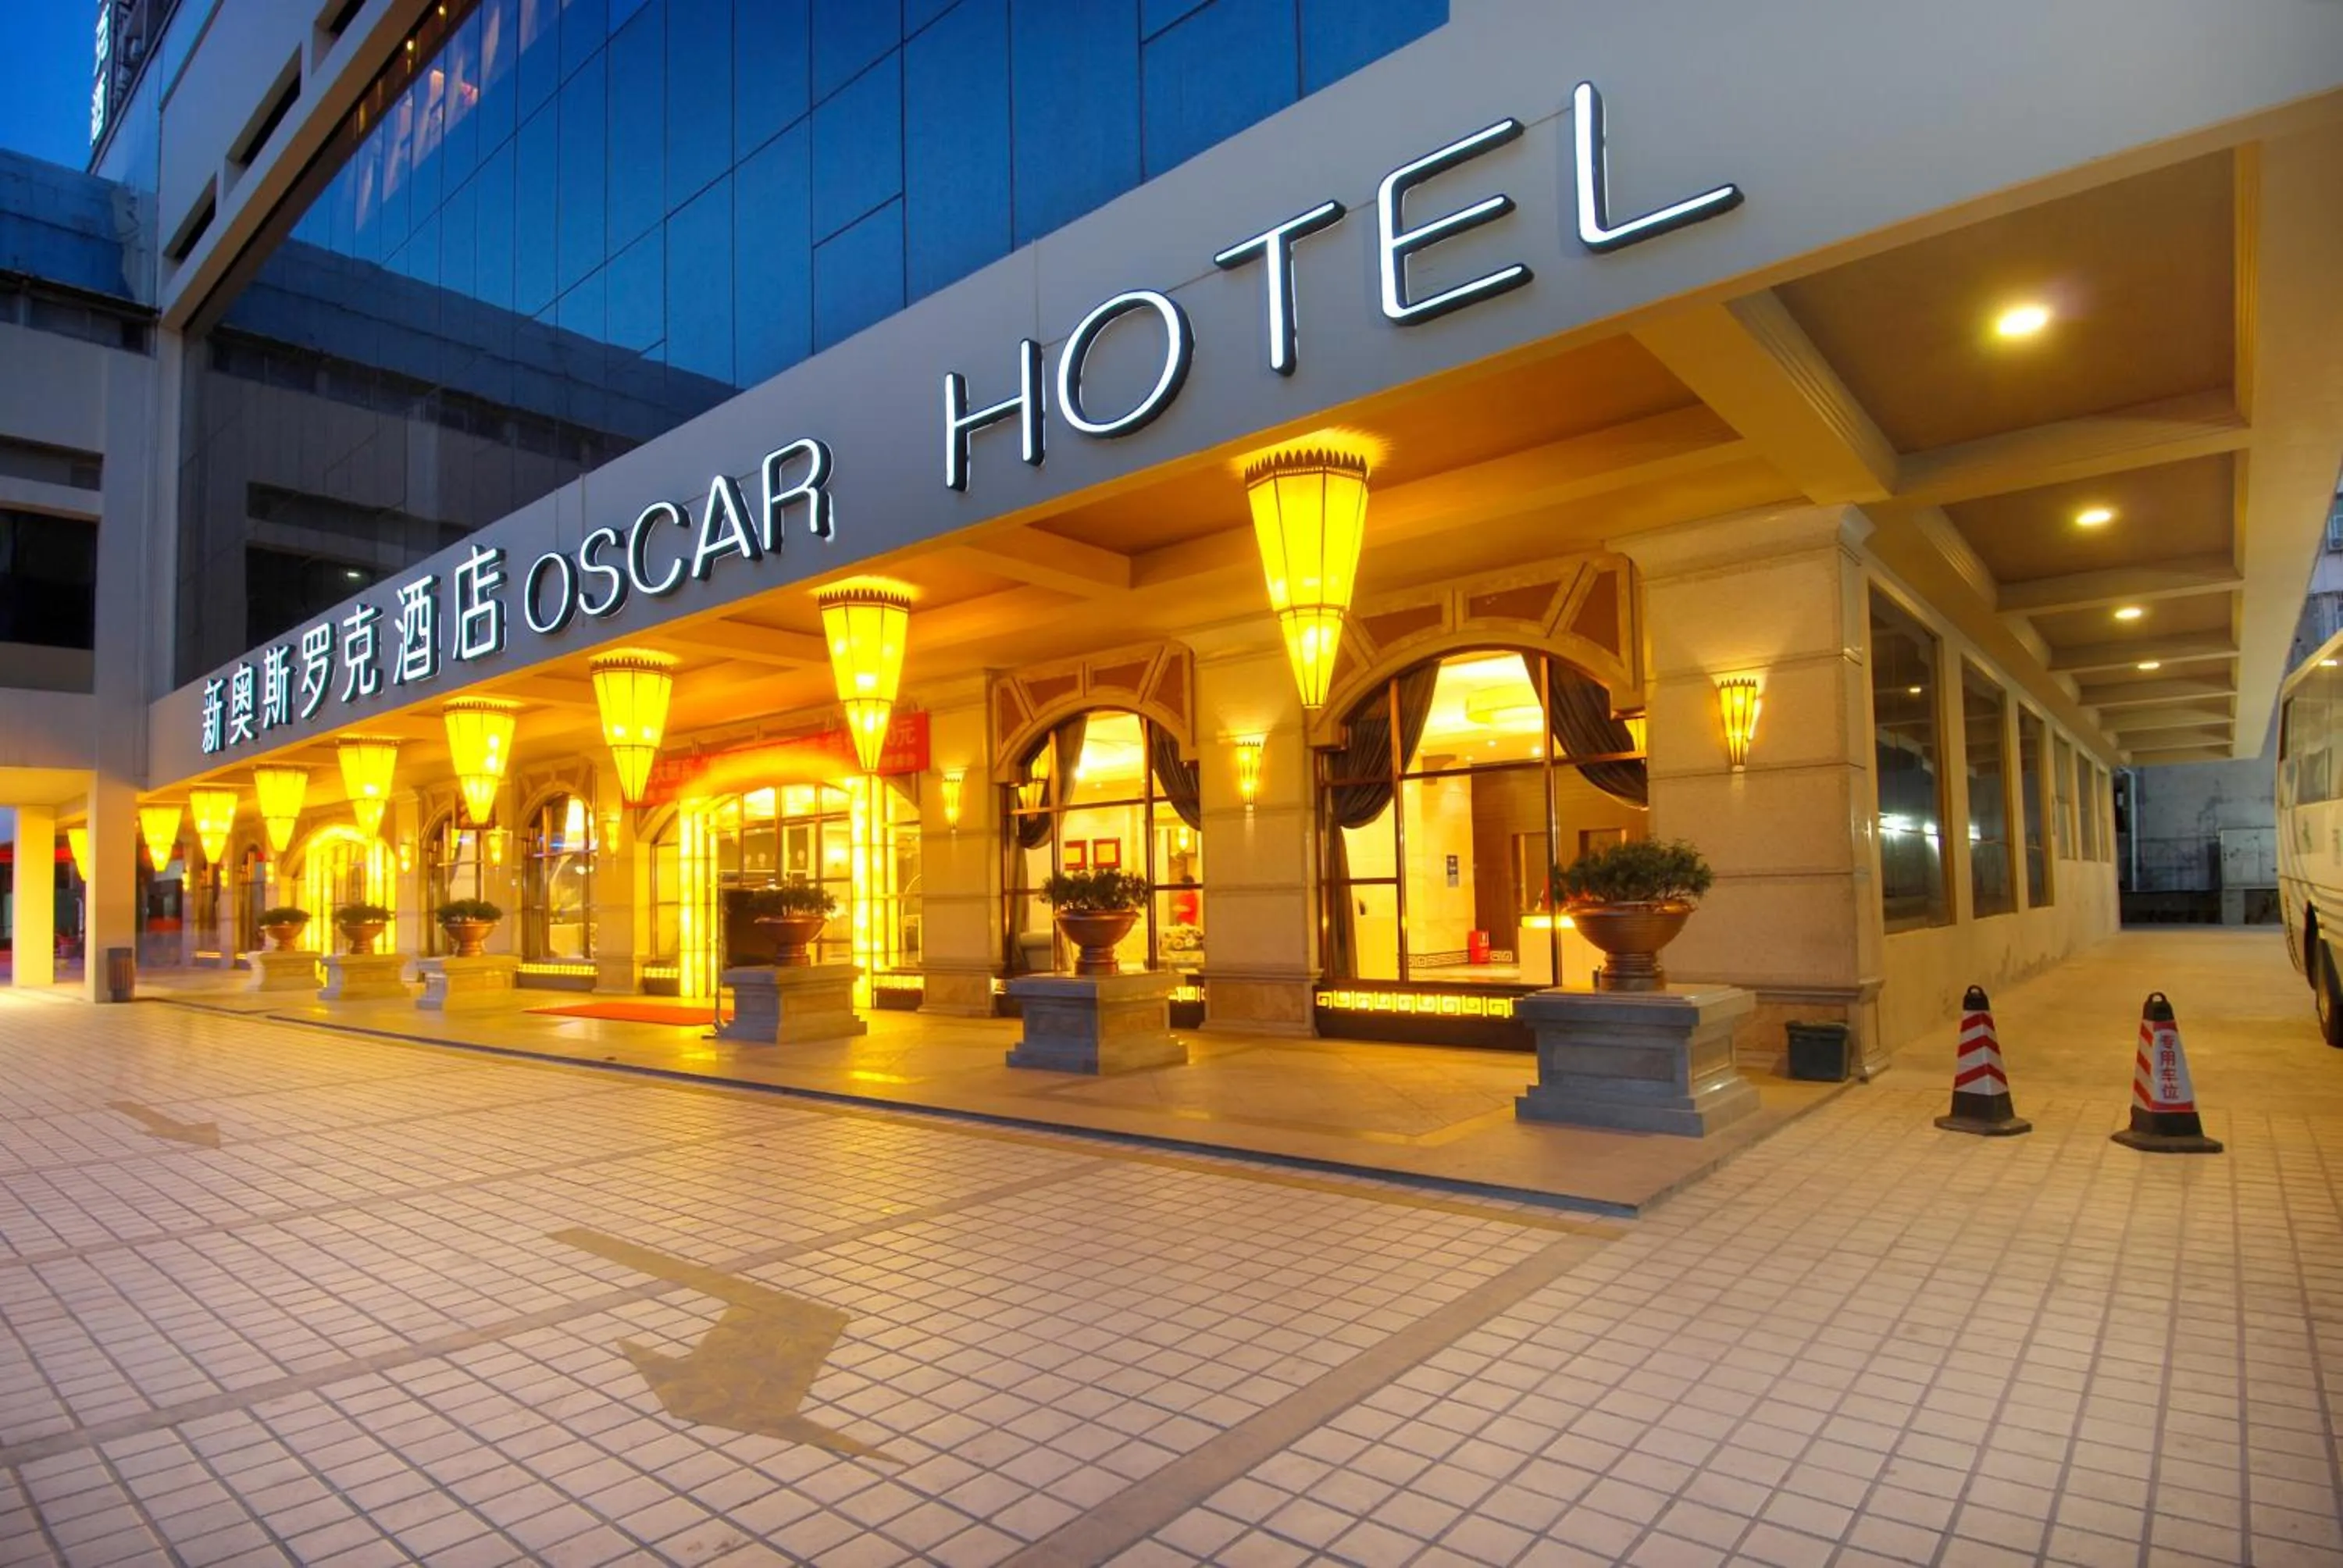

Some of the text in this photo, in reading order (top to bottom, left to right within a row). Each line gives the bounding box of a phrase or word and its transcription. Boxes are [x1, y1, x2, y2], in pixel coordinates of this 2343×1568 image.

[524, 80, 1745, 634] OSCAR HOTEL
[201, 543, 508, 754] 新奥斯罗克酒店
